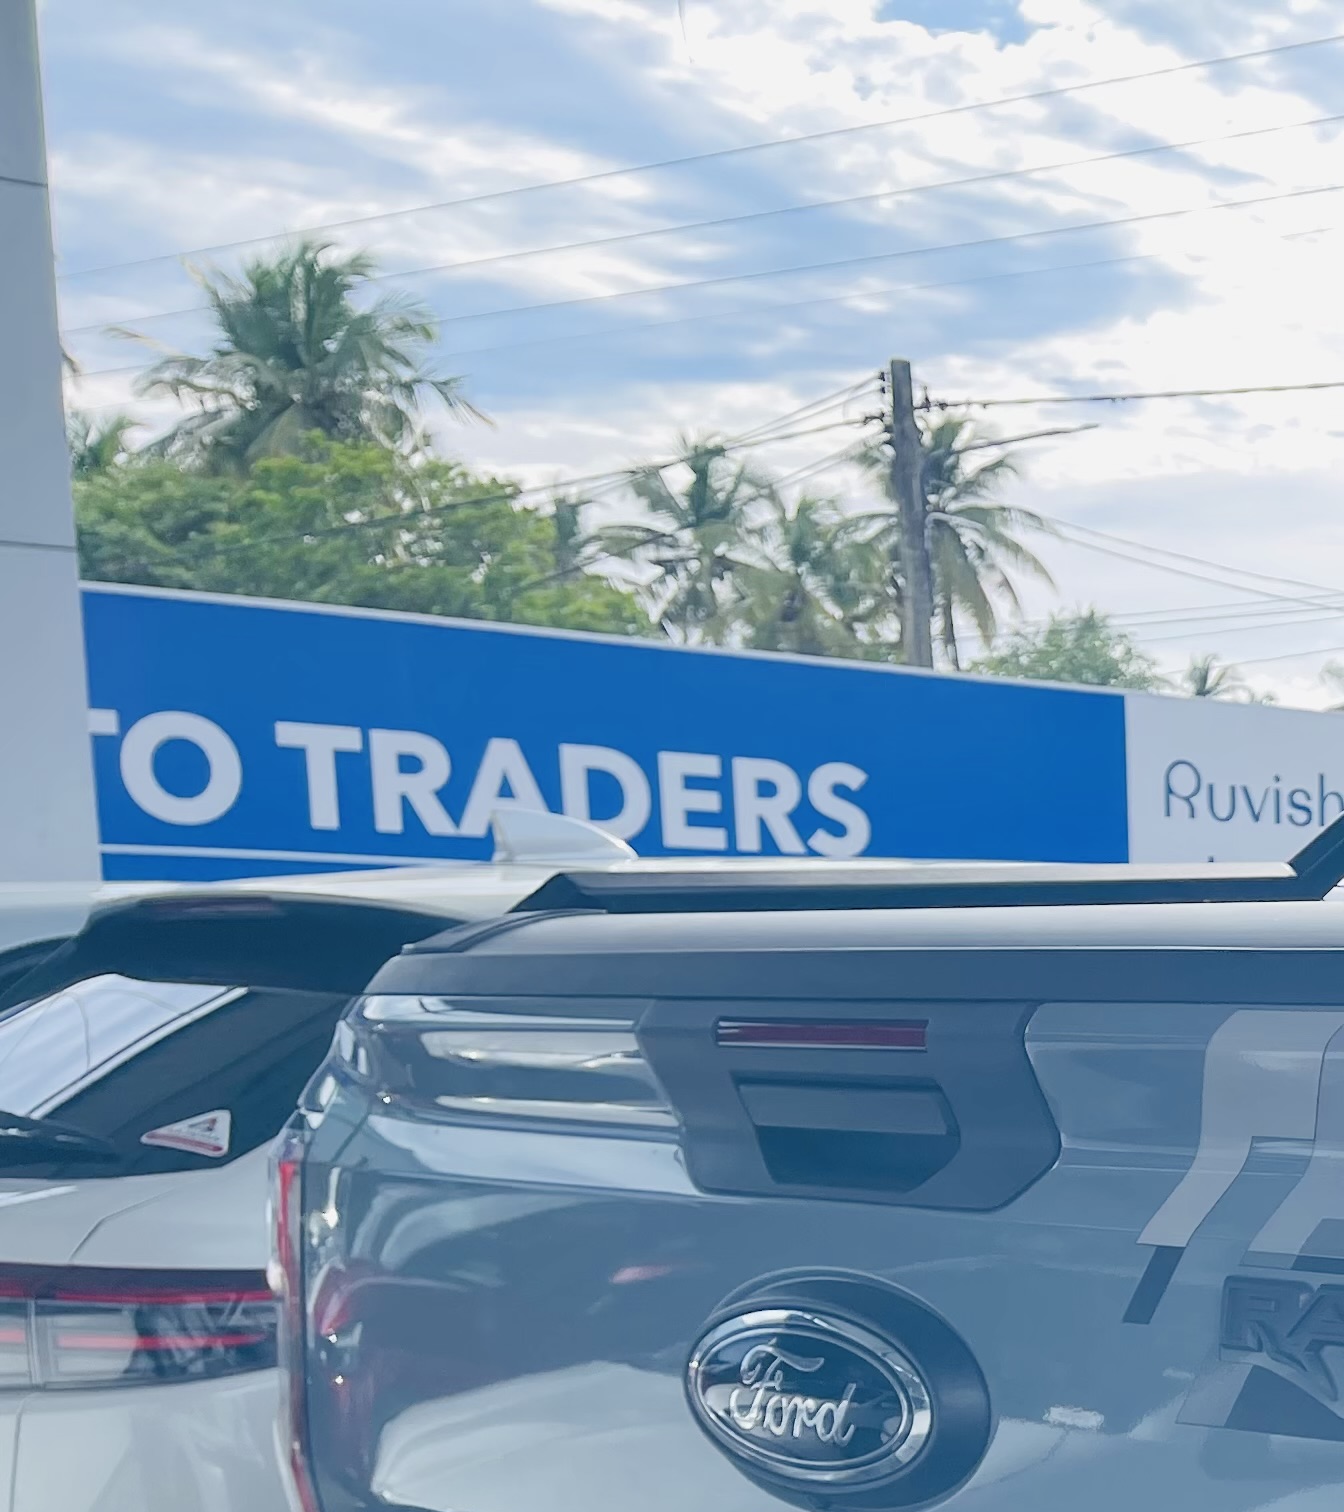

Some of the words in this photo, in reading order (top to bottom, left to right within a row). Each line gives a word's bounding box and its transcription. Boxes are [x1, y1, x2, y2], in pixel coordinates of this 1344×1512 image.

[89, 708, 242, 825] O
[274, 720, 872, 858] TRADERS
[728, 1336, 858, 1448] Ford
